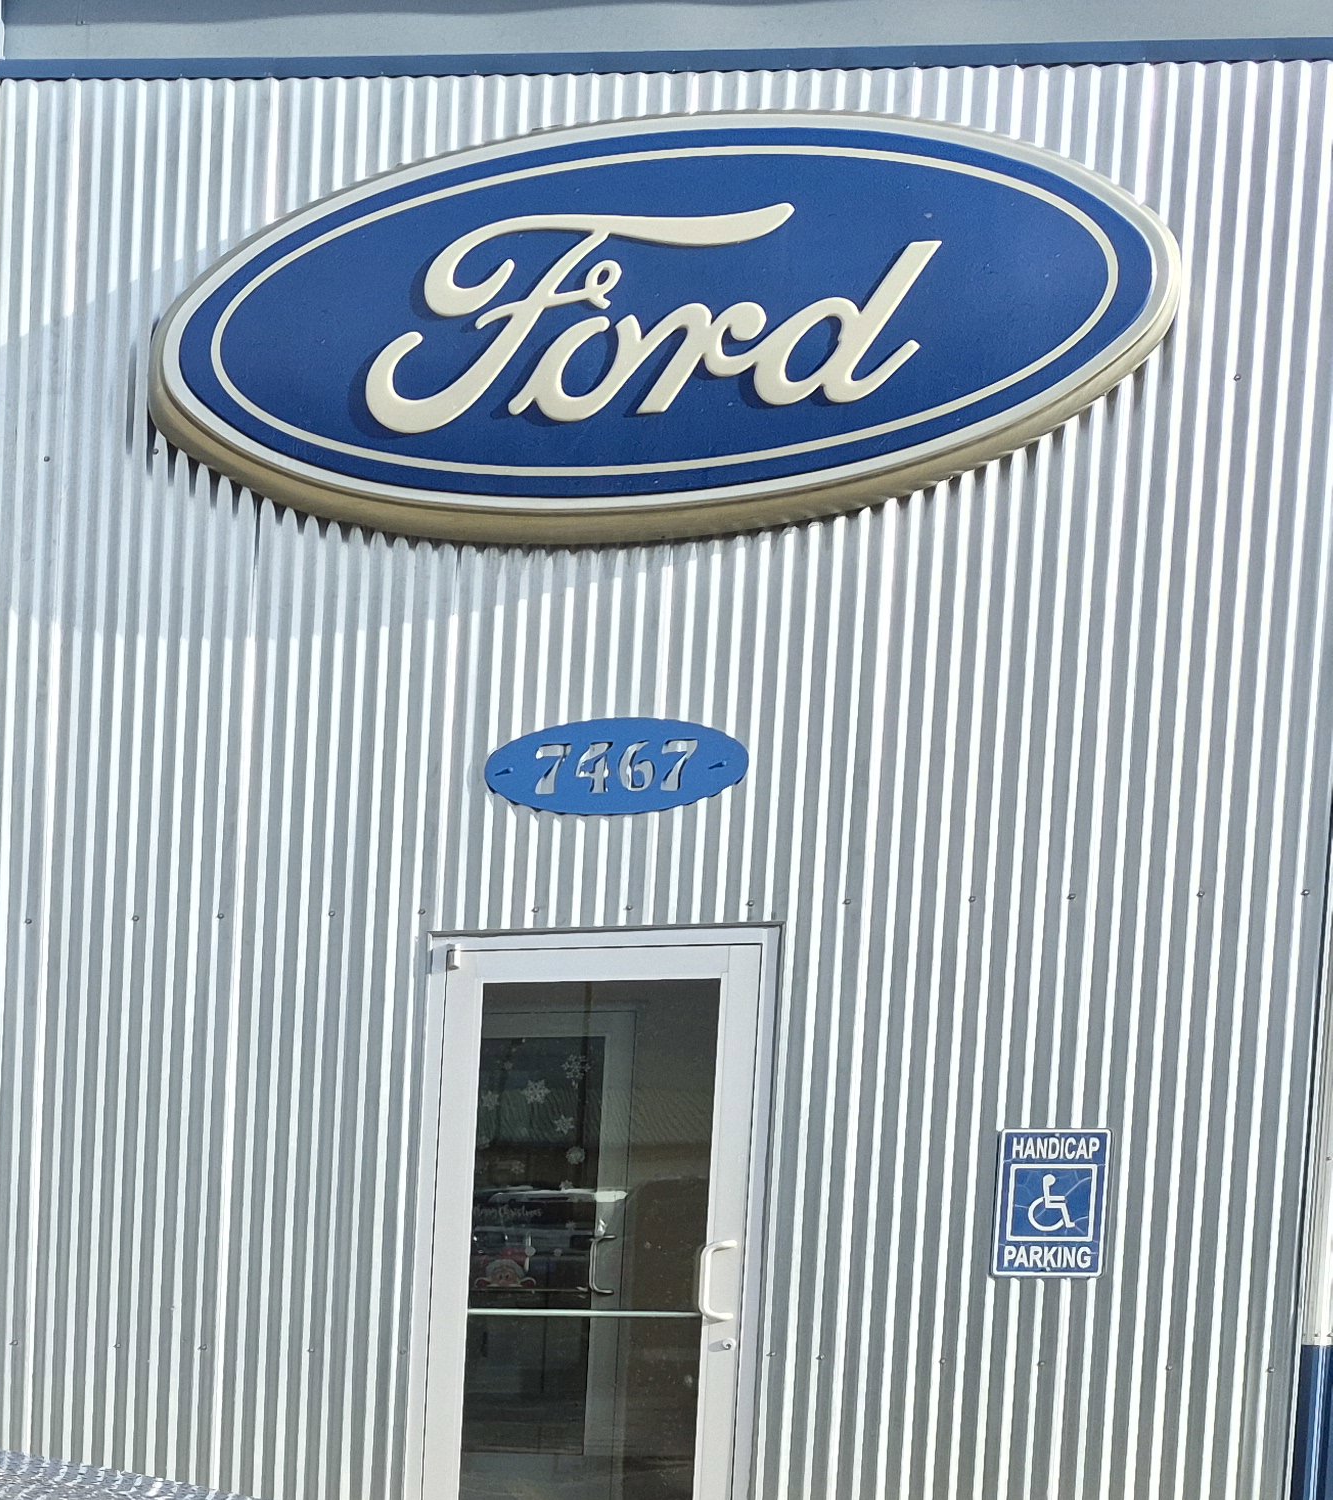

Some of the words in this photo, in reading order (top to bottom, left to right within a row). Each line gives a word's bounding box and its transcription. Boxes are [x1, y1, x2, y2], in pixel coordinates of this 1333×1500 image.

[364, 201, 942, 434] Ford
[535, 738, 699, 795] 7467
[1011, 1136, 1101, 1160] HANDICAP
[1002, 1245, 1092, 1269] PARKING
